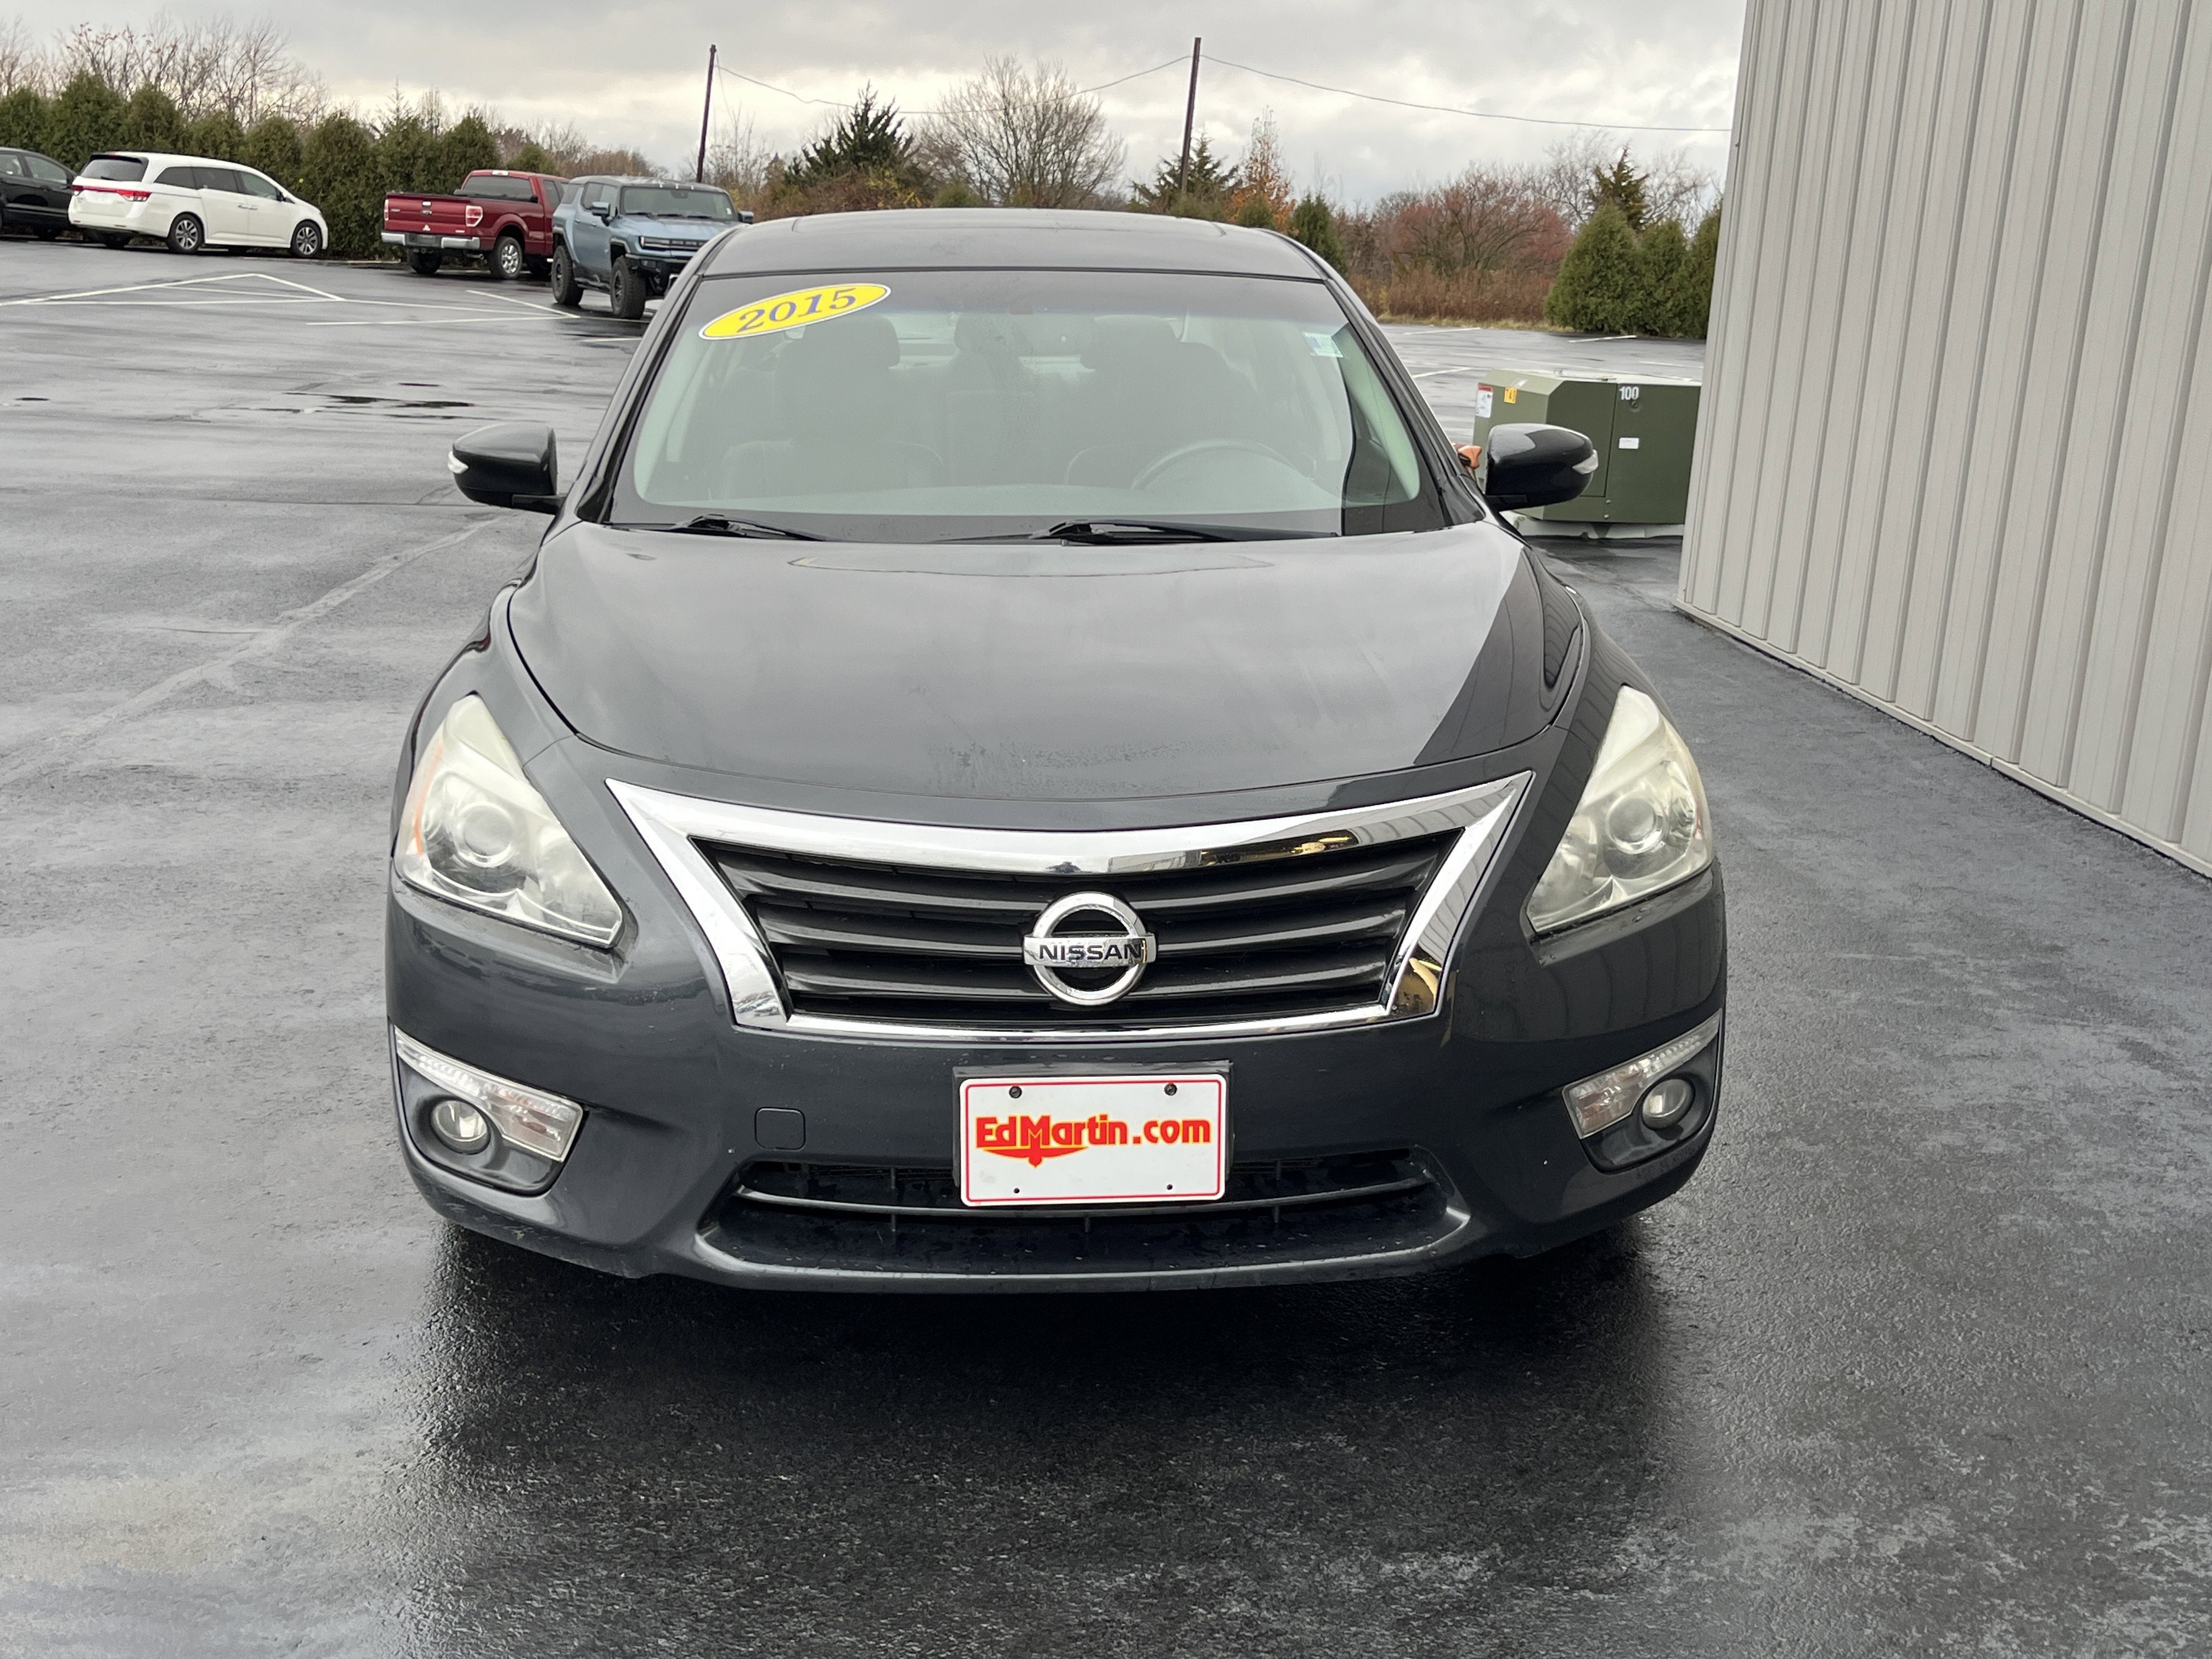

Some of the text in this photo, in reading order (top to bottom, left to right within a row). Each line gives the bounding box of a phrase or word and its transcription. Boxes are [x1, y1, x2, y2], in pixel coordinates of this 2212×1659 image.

[736, 287, 856, 332] 2015
[1619, 386, 1639, 400] 100
[1040, 944, 1142, 960] NISSAN
[975, 1114, 1211, 1148] EdMartin.com
